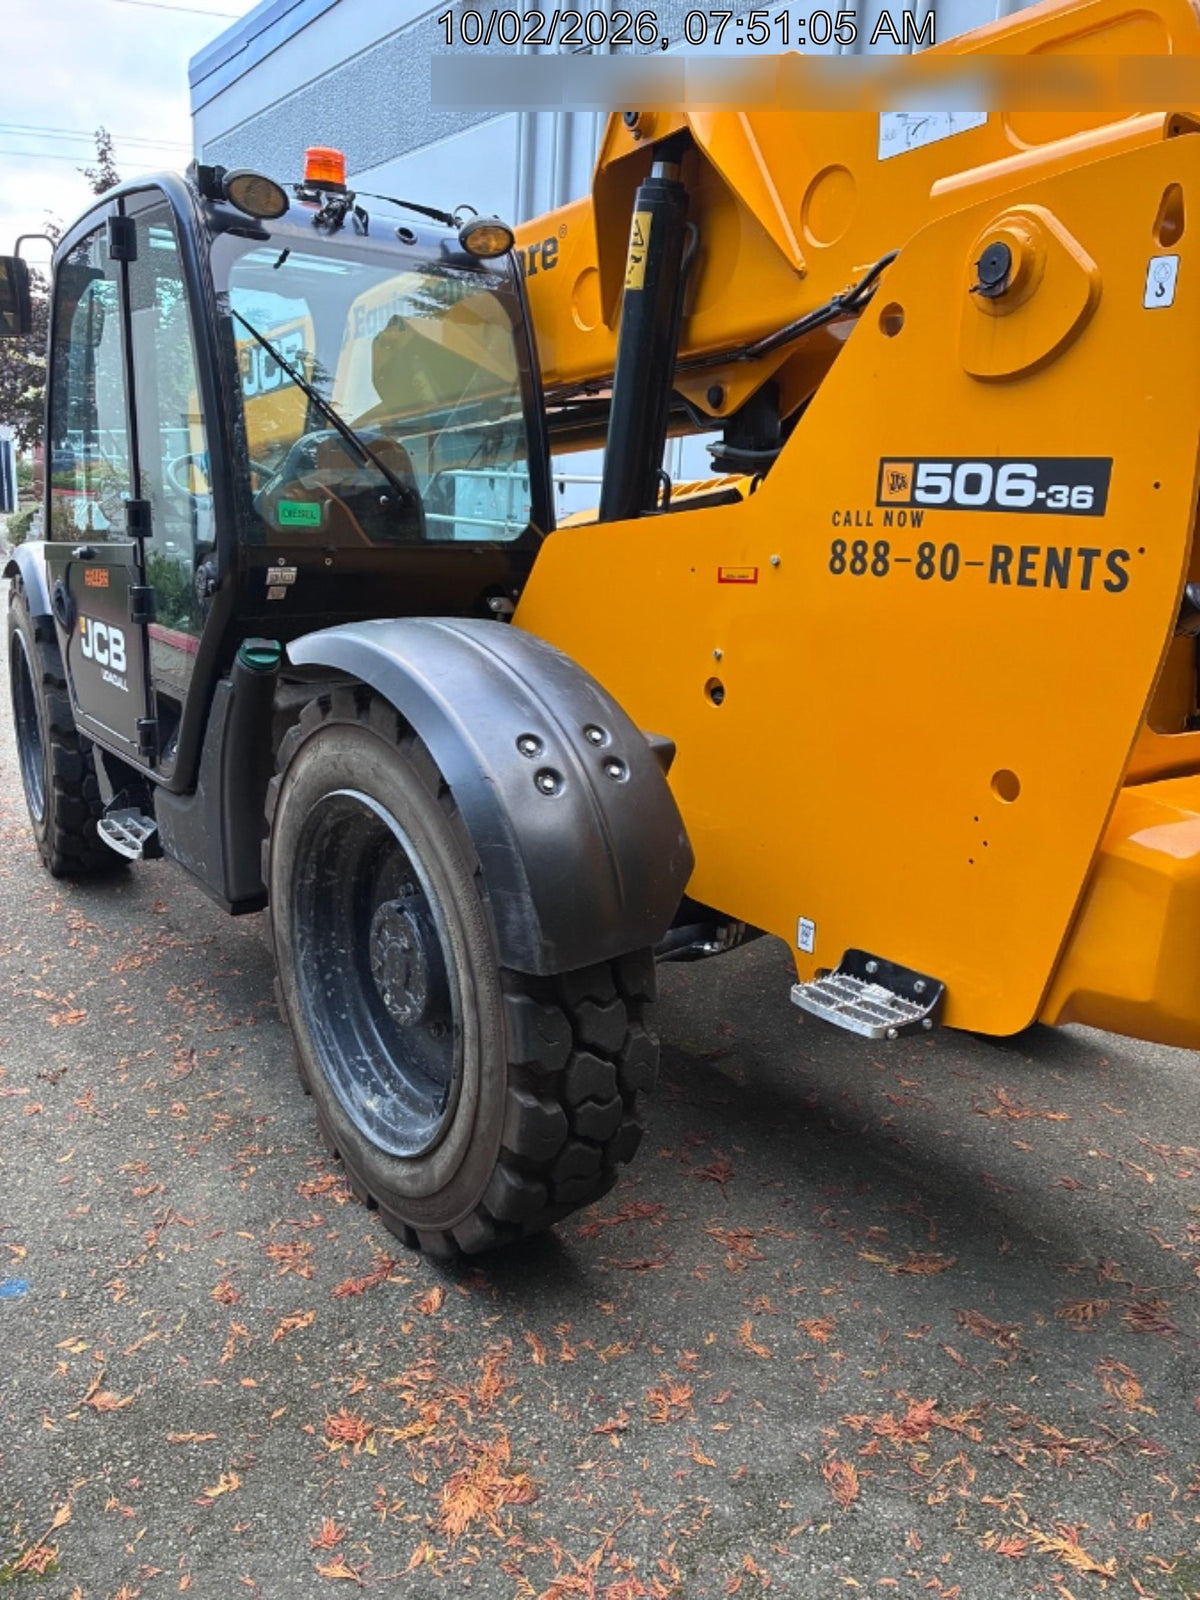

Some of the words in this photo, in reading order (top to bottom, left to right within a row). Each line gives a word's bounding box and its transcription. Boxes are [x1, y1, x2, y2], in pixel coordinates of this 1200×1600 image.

[915, 463, 1094, 509] 506-36
[831, 510, 874, 527] CALL
[883, 511, 925, 529] NOW
[79, 616, 127, 673] JCB
